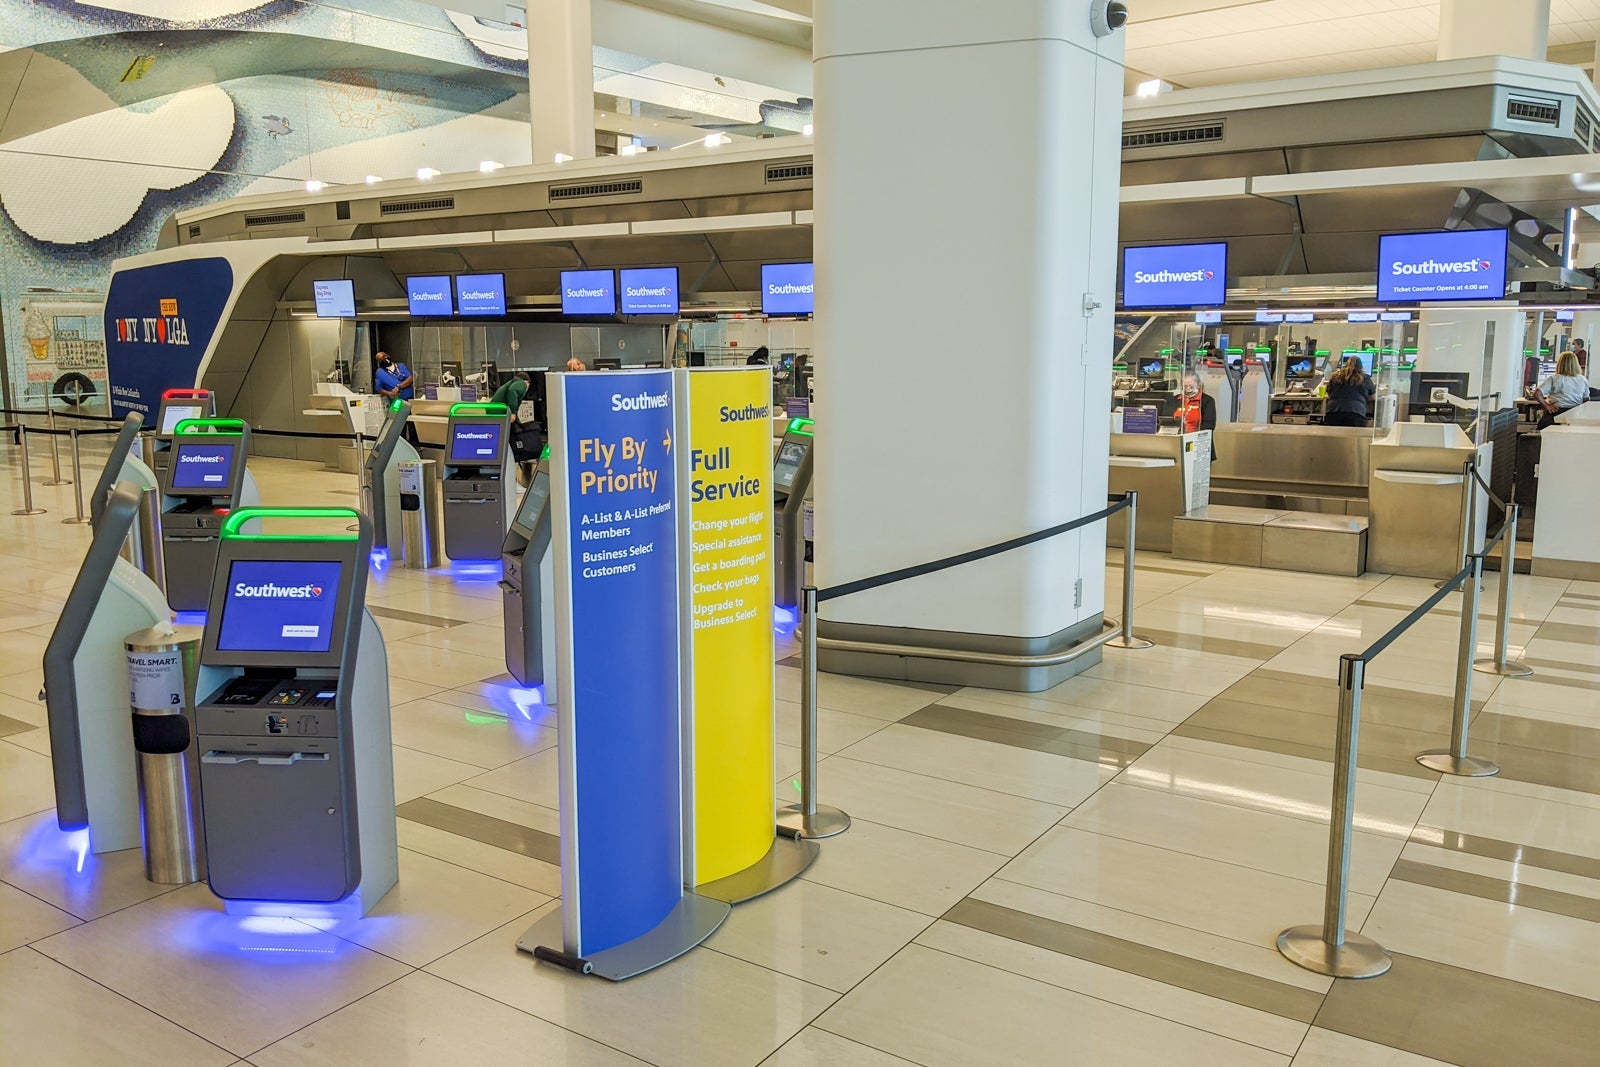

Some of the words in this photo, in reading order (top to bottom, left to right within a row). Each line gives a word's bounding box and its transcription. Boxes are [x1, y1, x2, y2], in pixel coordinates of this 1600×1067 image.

[1134, 269, 1203, 283] Southwest
[1392, 259, 1478, 276] Southwest
[412, 292, 443, 301] Southwest
[462, 290, 495, 300] Southwest
[567, 287, 603, 298] Southwest
[626, 286, 666, 297] Southwest
[769, 283, 814, 295] Southwest
[611, 391, 668, 412] Southwest
[180, 454, 219, 463] Southwest
[579, 437, 616, 469] Fly
[622, 436, 647, 466] By
[691, 447, 730, 472] Full
[580, 465, 660, 495] Priority
[691, 474, 760, 503] Service
[581, 511, 613, 526] A-List
[614, 510, 623, 522] &
[624, 507, 649, 521] A-List
[649, 499, 671, 517] Preferred
[692, 519, 728, 532] Change
[730, 516, 748, 529] your
[749, 511, 764, 524] flight
[581, 525, 631, 541] Members
[692, 538, 727, 553] Special
[728, 532, 762, 547] assistance
[582, 548, 628, 563] Business
[629, 542, 654, 557] Select
[582, 562, 637, 579] Customers
[692, 562, 711, 573] Get
[712, 562, 718, 571] a
[719, 554, 755, 570] boarding
[234, 582, 312, 598] Southwest
[692, 577, 723, 594] Check
[724, 576, 744, 592] your
[744, 573, 760, 587] bags
[693, 599, 734, 616] Upgrade
[735, 597, 744, 607] to
[693, 614, 734, 630] Business
[735, 607, 757, 622] Select
